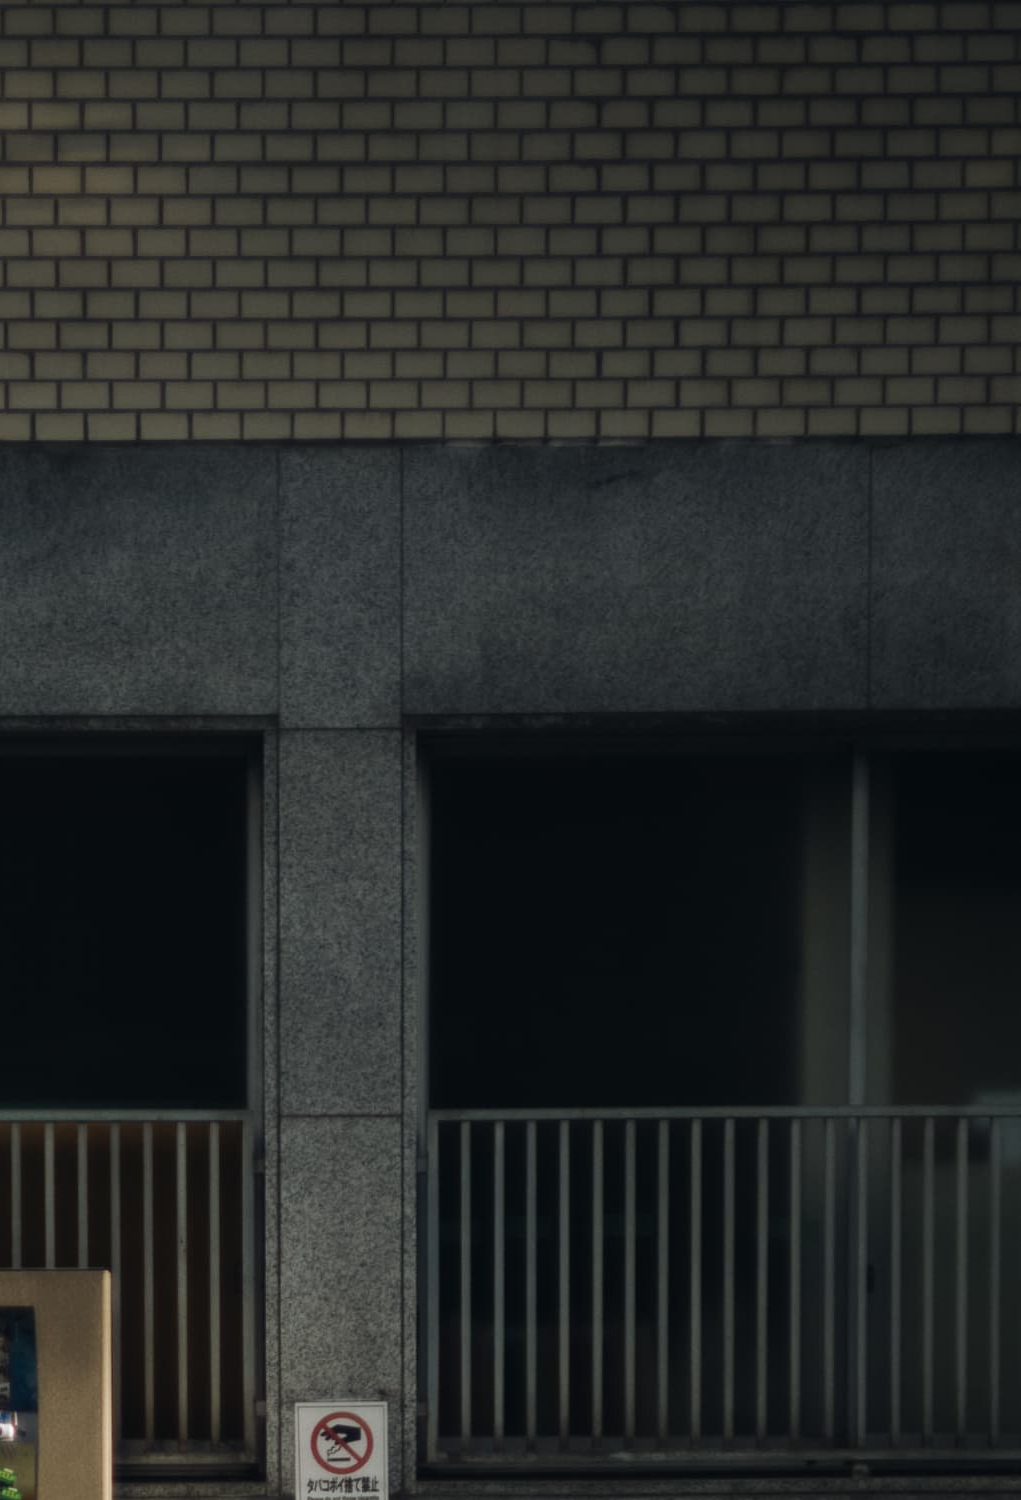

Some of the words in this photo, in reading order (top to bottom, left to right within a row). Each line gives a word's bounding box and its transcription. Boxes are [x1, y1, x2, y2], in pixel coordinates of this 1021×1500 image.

[306, 1475, 380, 1494] タバコポイ捨て禁止
